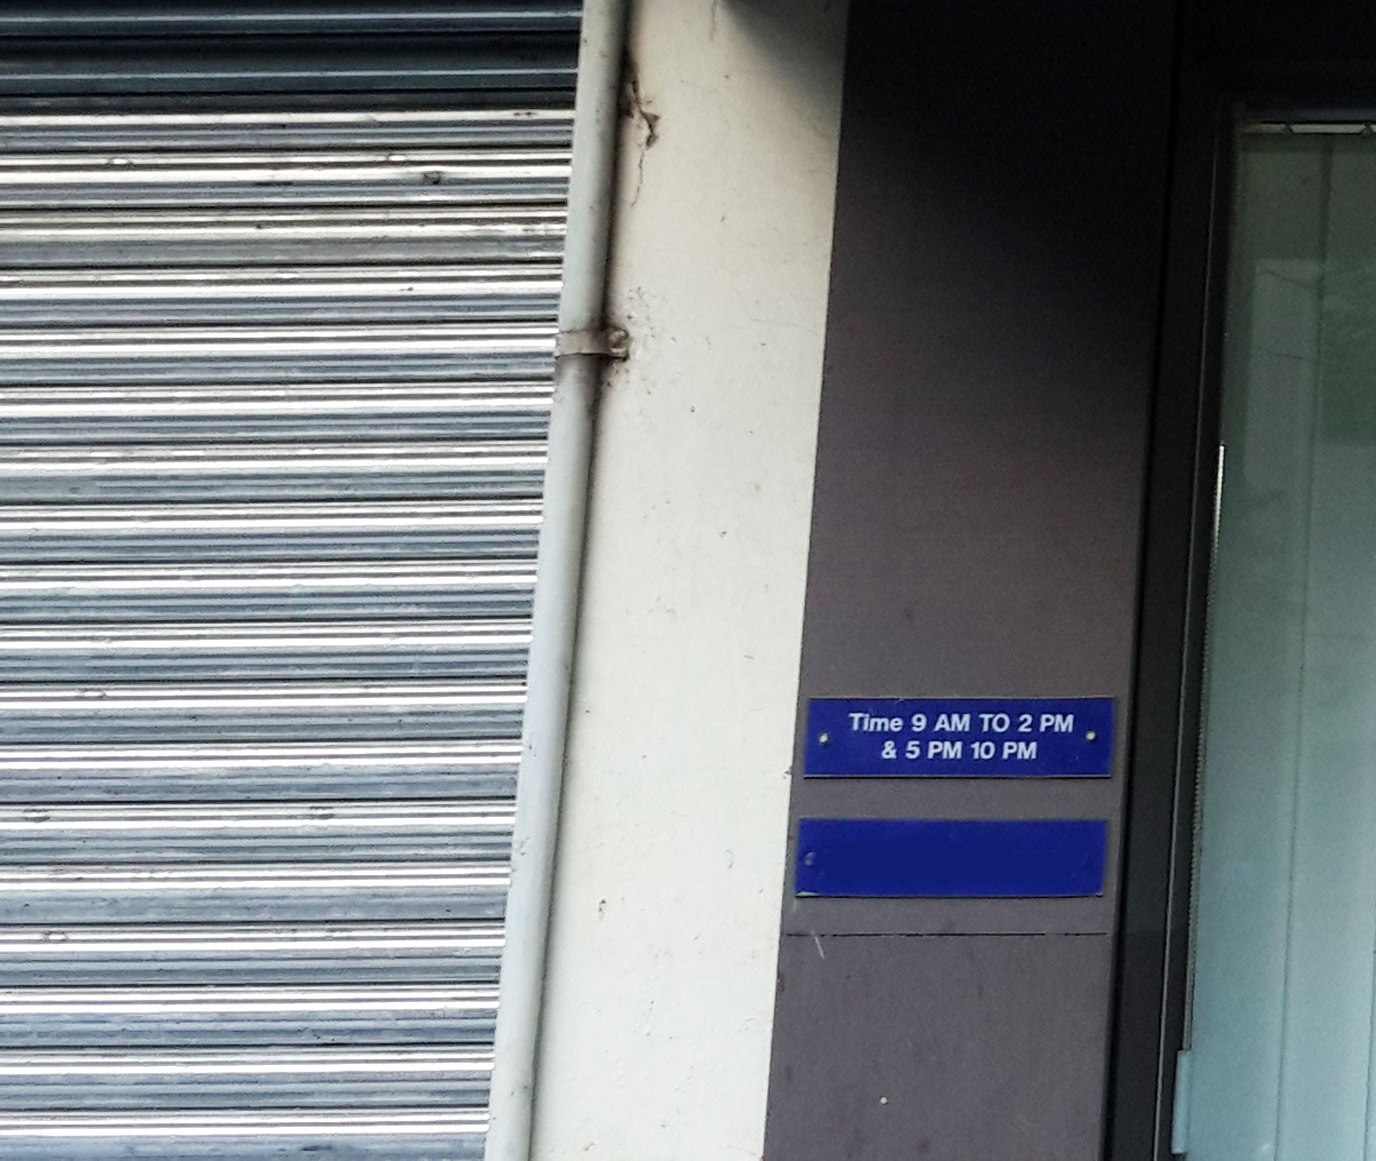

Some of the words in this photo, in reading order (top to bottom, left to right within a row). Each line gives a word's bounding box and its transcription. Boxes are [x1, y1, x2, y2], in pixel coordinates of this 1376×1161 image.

[849, 712, 903, 732] Time
[911, 713, 927, 732] 9
[934, 713, 971, 732] AM
[978, 713, 1010, 732] TO
[1018, 713, 1033, 732] 2
[1039, 713, 1074, 732] PM
[881, 740, 897, 759] &
[905, 740, 920, 759] 5
[927, 741, 962, 759] PM
[970, 741, 996, 759] 10
[1002, 741, 1038, 760] PM
